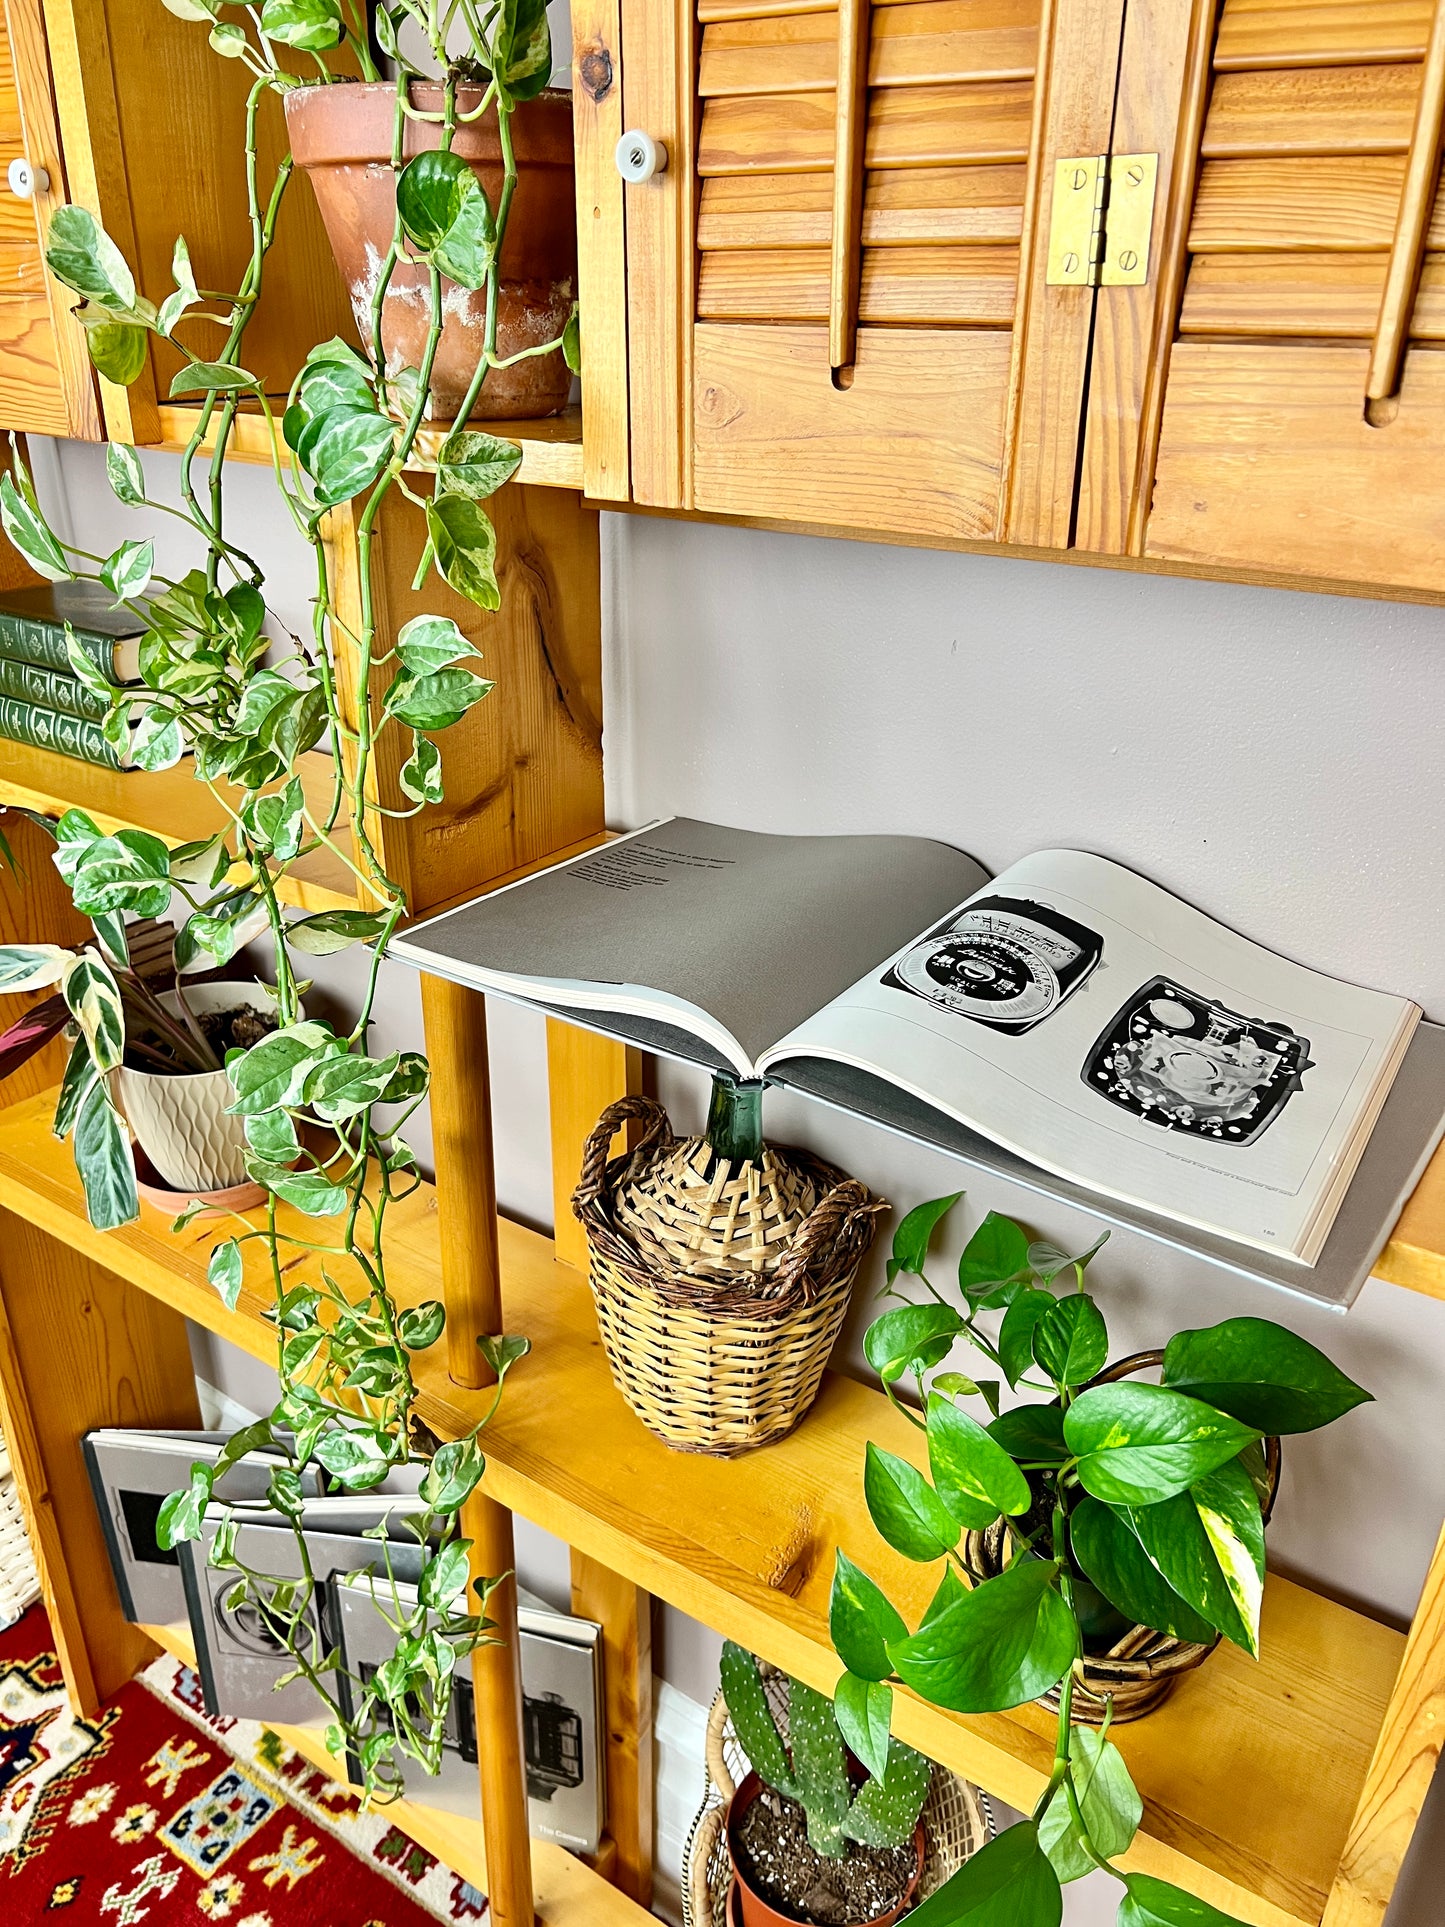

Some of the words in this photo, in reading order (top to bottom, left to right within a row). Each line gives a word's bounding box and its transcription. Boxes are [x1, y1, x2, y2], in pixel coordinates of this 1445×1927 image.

[949, 975, 978, 990] SCALE
[538, 1824, 555, 1835] The
[555, 1829, 588, 1846] Camera
